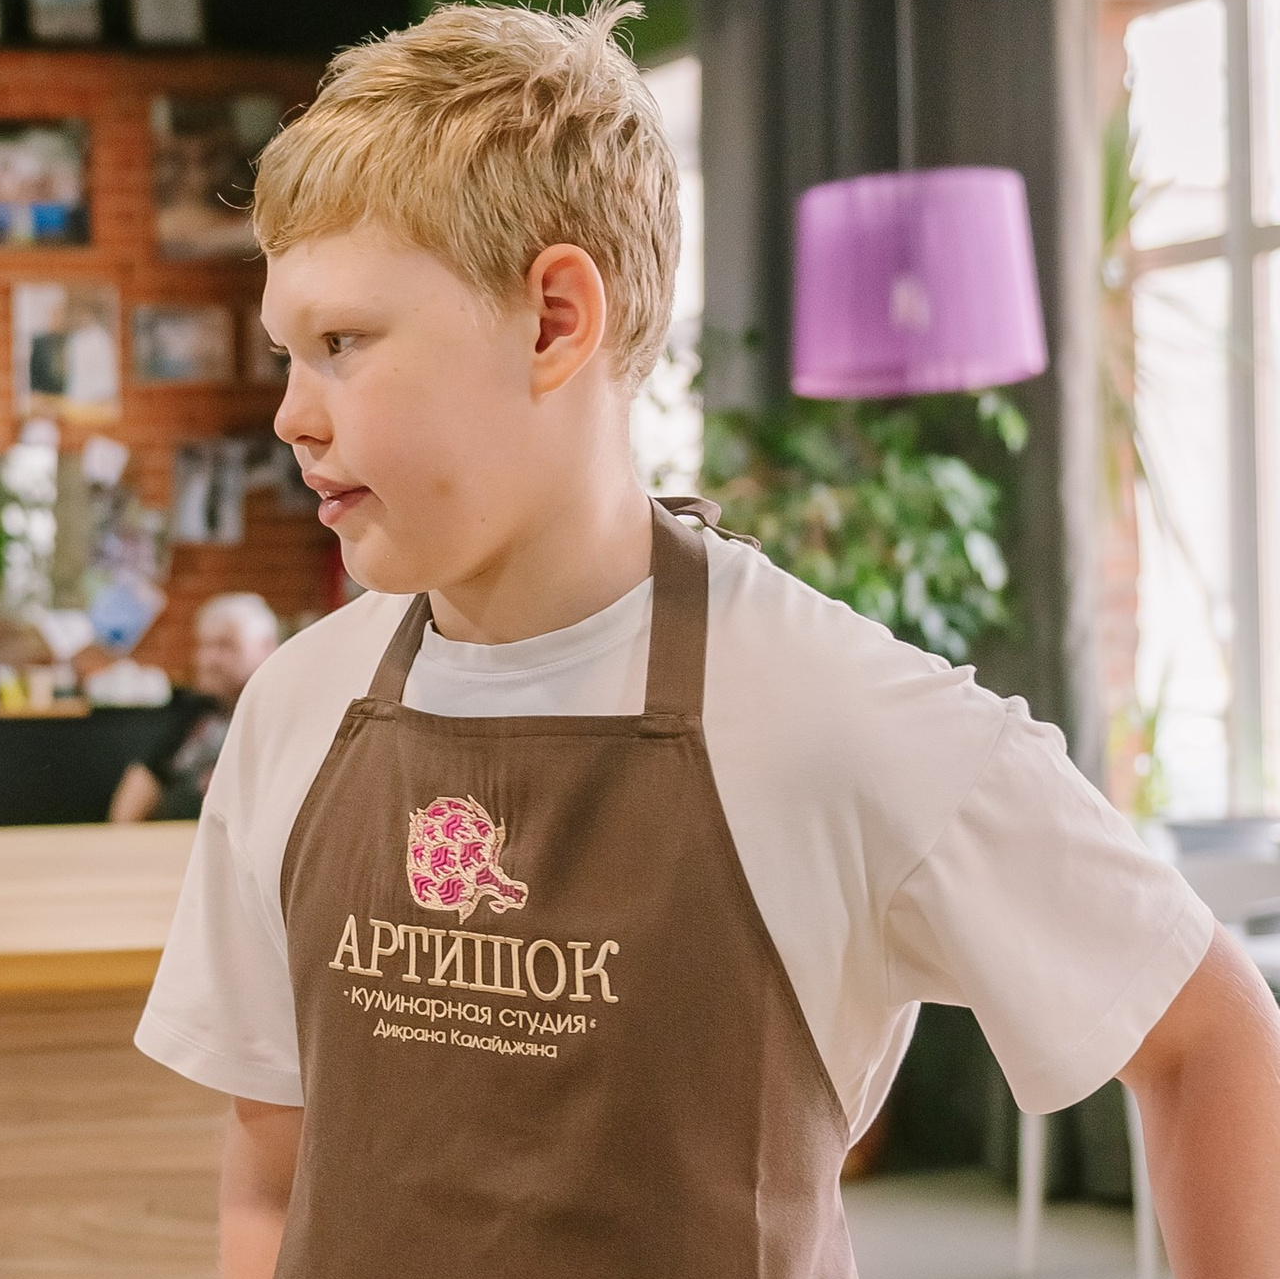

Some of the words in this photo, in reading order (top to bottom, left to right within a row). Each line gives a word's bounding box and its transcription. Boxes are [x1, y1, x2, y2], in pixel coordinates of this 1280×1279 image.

[329, 914, 620, 1003] АРТИШОК
[373, 1018, 446, 1044] Дикрана
[450, 1029, 558, 1059] Калайджяна
